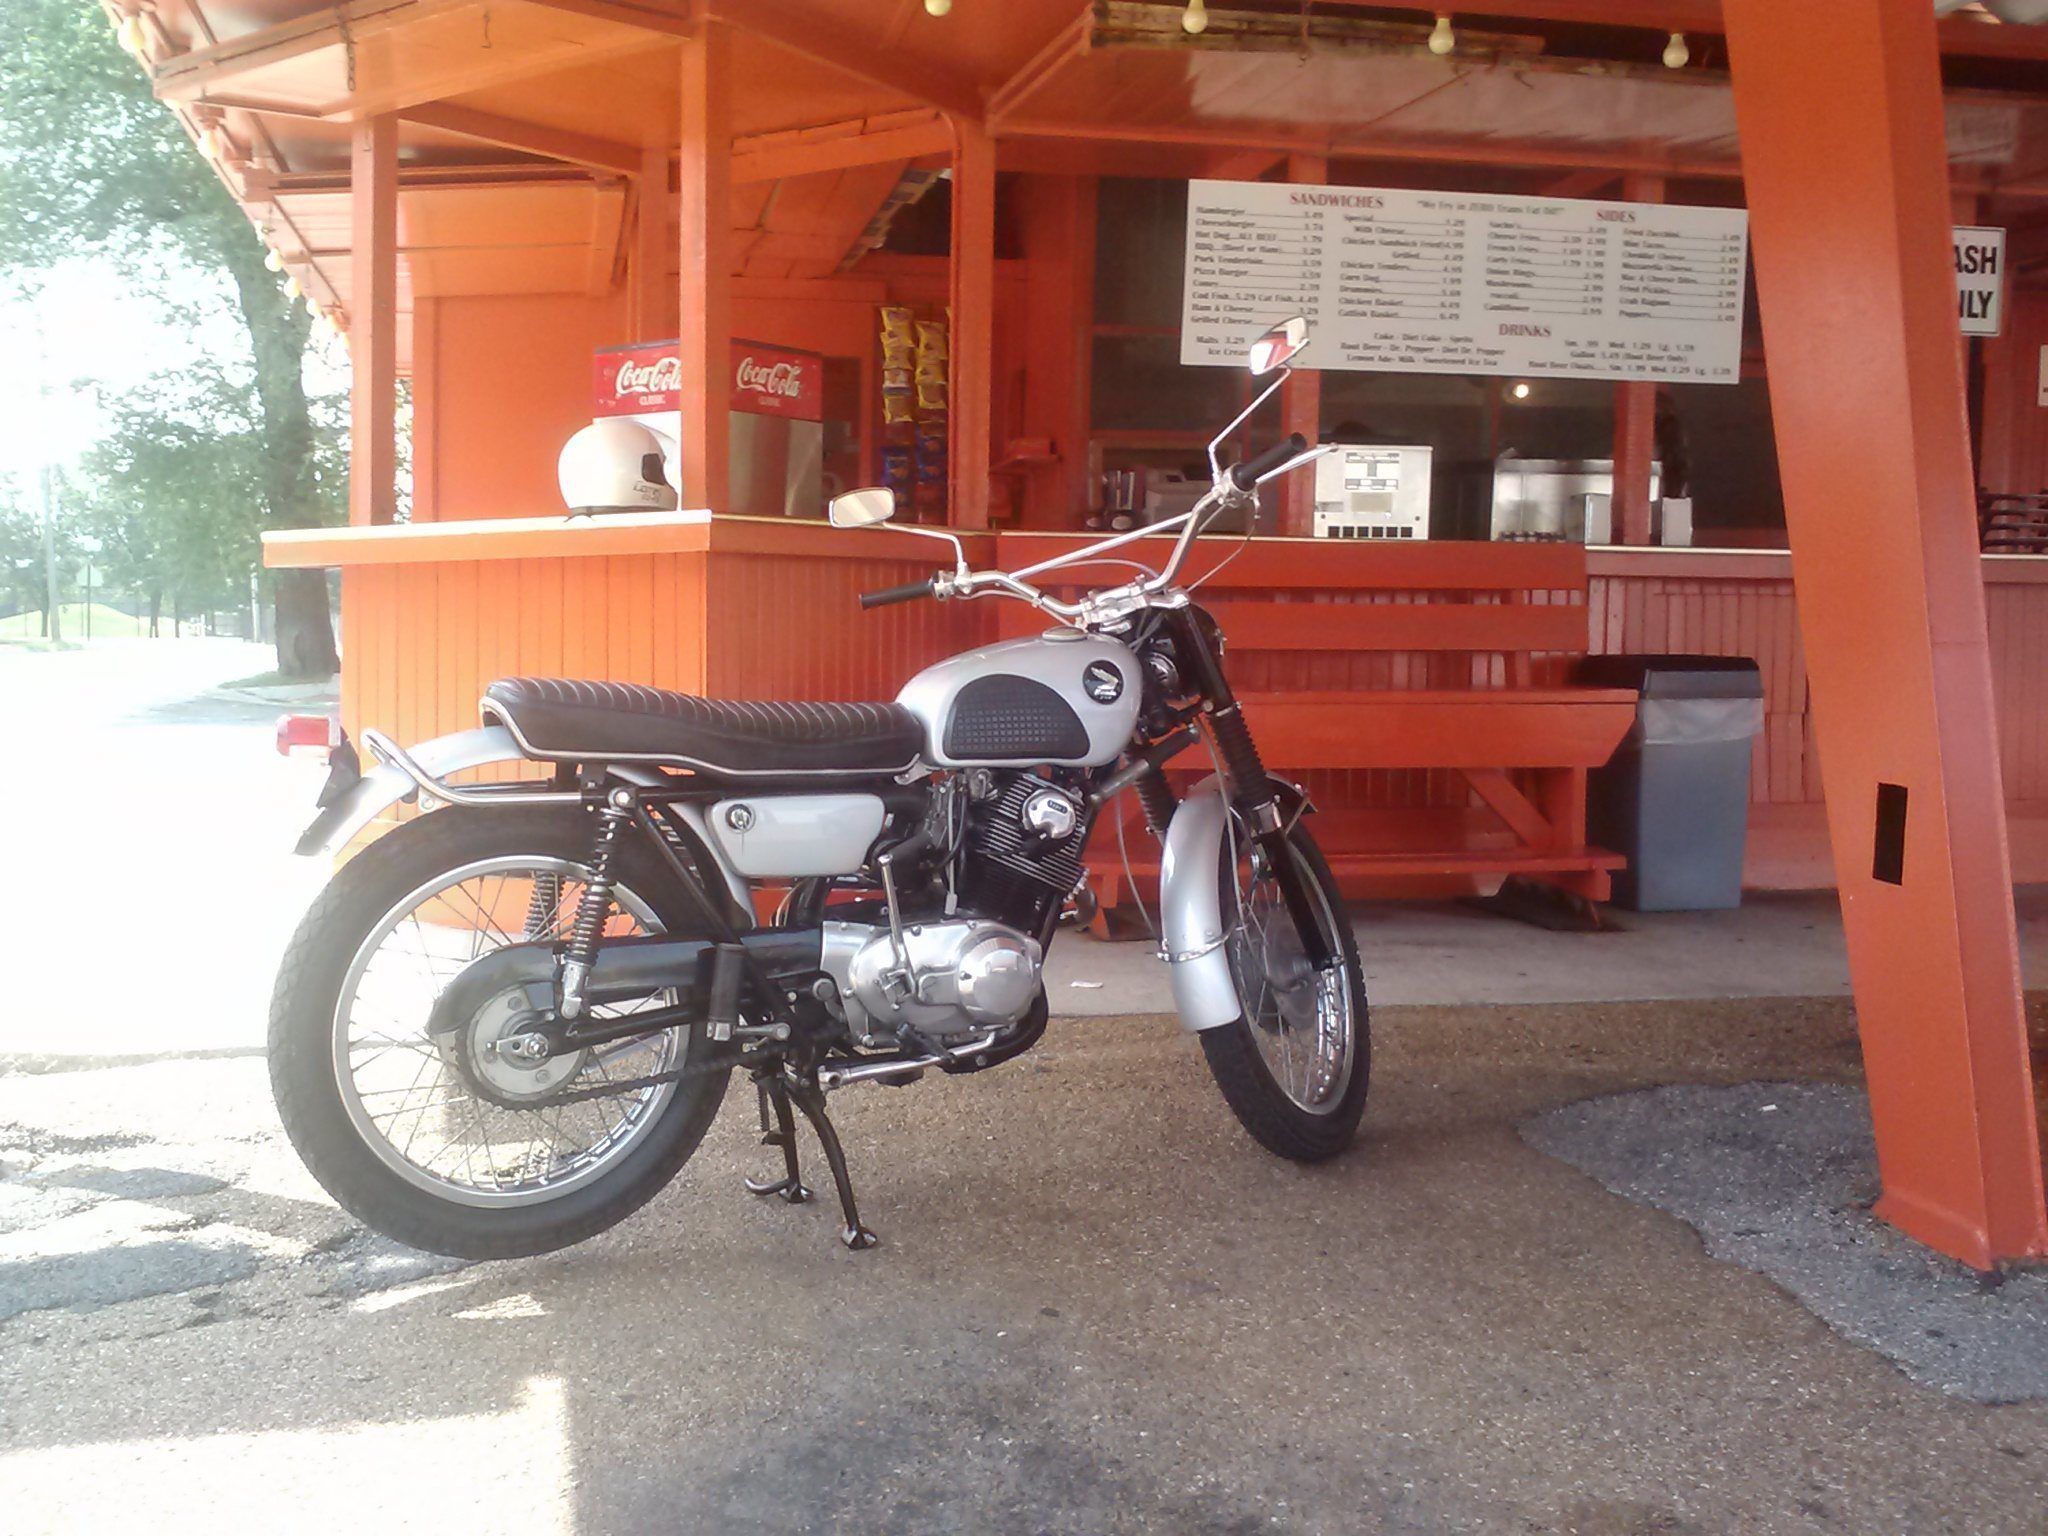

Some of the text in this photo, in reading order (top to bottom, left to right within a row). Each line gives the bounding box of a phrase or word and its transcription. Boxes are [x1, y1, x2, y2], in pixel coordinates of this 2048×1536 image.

[1290, 192, 1383, 208] SANDWICHES
[1196, 206, 1245, 216] Hamburger
[1596, 209, 1635, 222] SIDES
[1195, 218, 1255, 229] Cheeseburger
[1375, 226, 1404, 234] Cheese
[1212, 231, 1230, 240] Dog
[1379, 238, 1417, 246] Sandwich
[1194, 254, 1213, 262] Pork
[1218, 268, 1248, 277] Burger
[1375, 298, 1403, 306] Basket
[1223, 304, 1253, 312] Cheese
[1370, 310, 1398, 318] Basket
[1498, 323, 1550, 336] DRINKS
